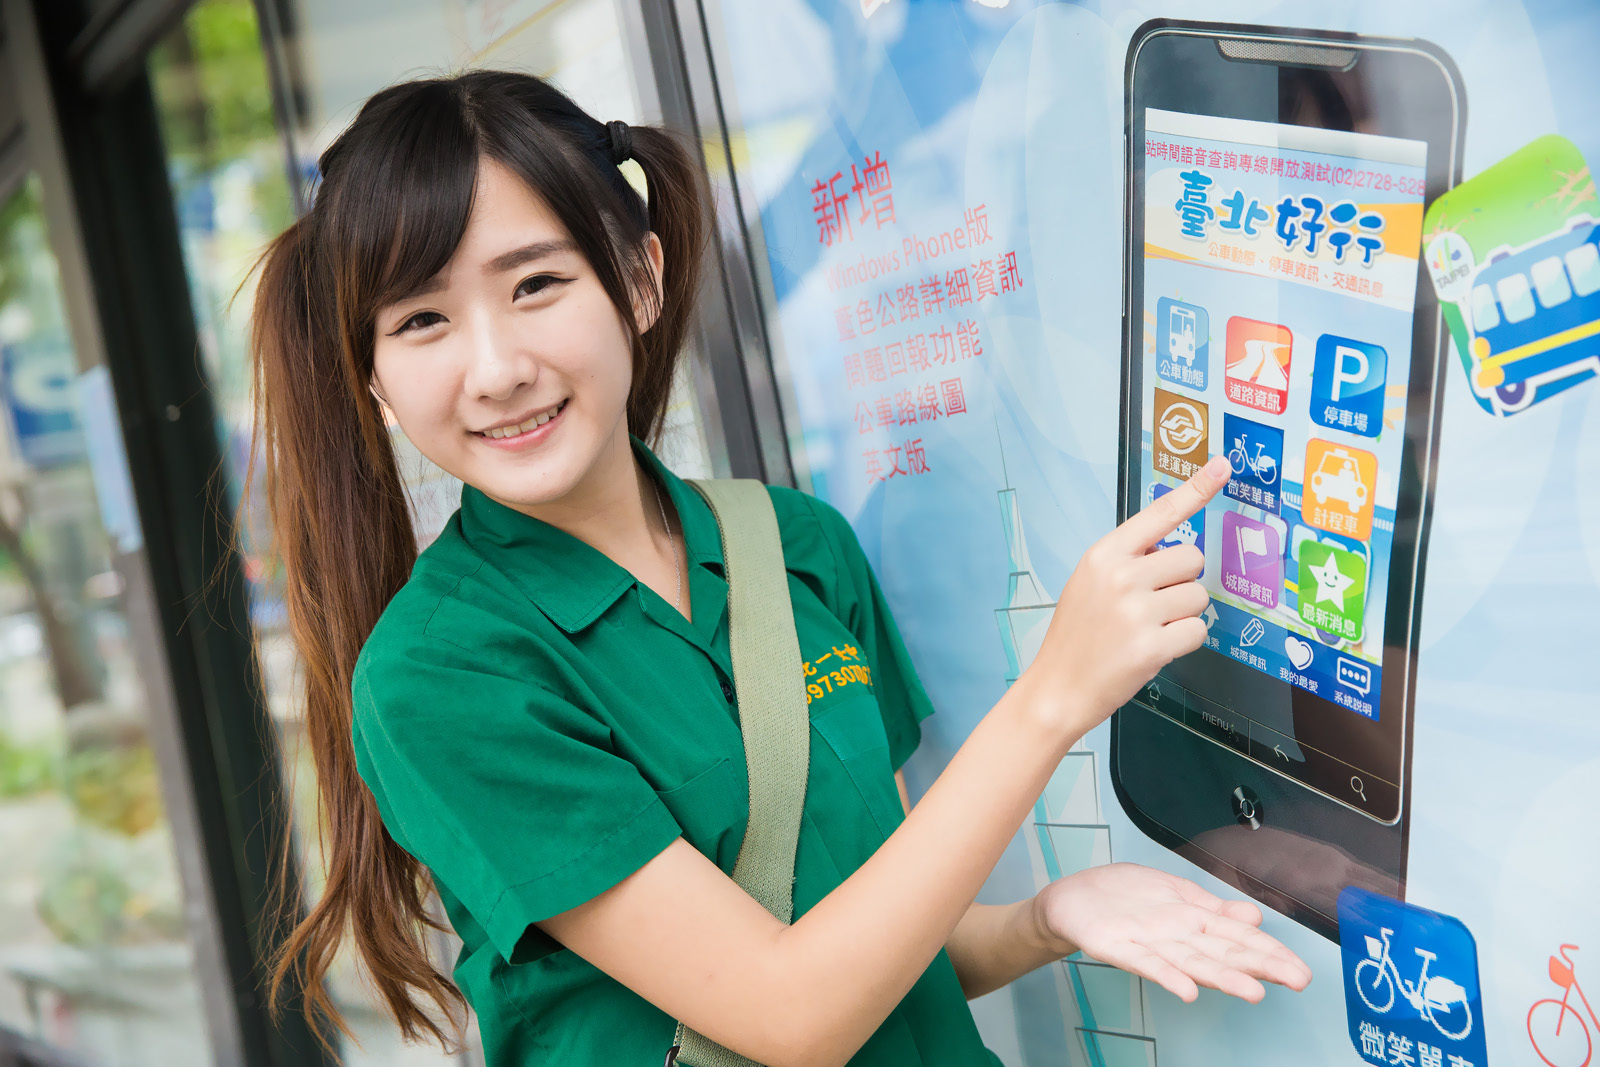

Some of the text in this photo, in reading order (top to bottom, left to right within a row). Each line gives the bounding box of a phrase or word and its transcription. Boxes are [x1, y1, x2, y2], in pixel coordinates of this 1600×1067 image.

[811, 150, 897, 248] 新增
[1174, 169, 1384, 265] 臺北好行
[824, 250, 901, 292] Windows
[834, 251, 1023, 342] 藍色公路詳細資訊
[843, 319, 983, 391] 問題回報功能
[1160, 359, 1204, 388] 公車動態
[1331, 345, 1369, 402] P
[853, 377, 967, 435] 公車路線圖
[1229, 382, 1281, 412] 道路資訊
[1323, 405, 1369, 432] 停車場
[862, 438, 931, 484] 英文版
[1227, 478, 1275, 509] 微笑單車
[1313, 507, 1358, 534] 計程車
[1225, 572, 1274, 606] 城際資訊
[1302, 603, 1357, 638] 最新消息
[1229, 645, 1267, 671] 城際資訊
[1279, 666, 1319, 694] 我的最愛
